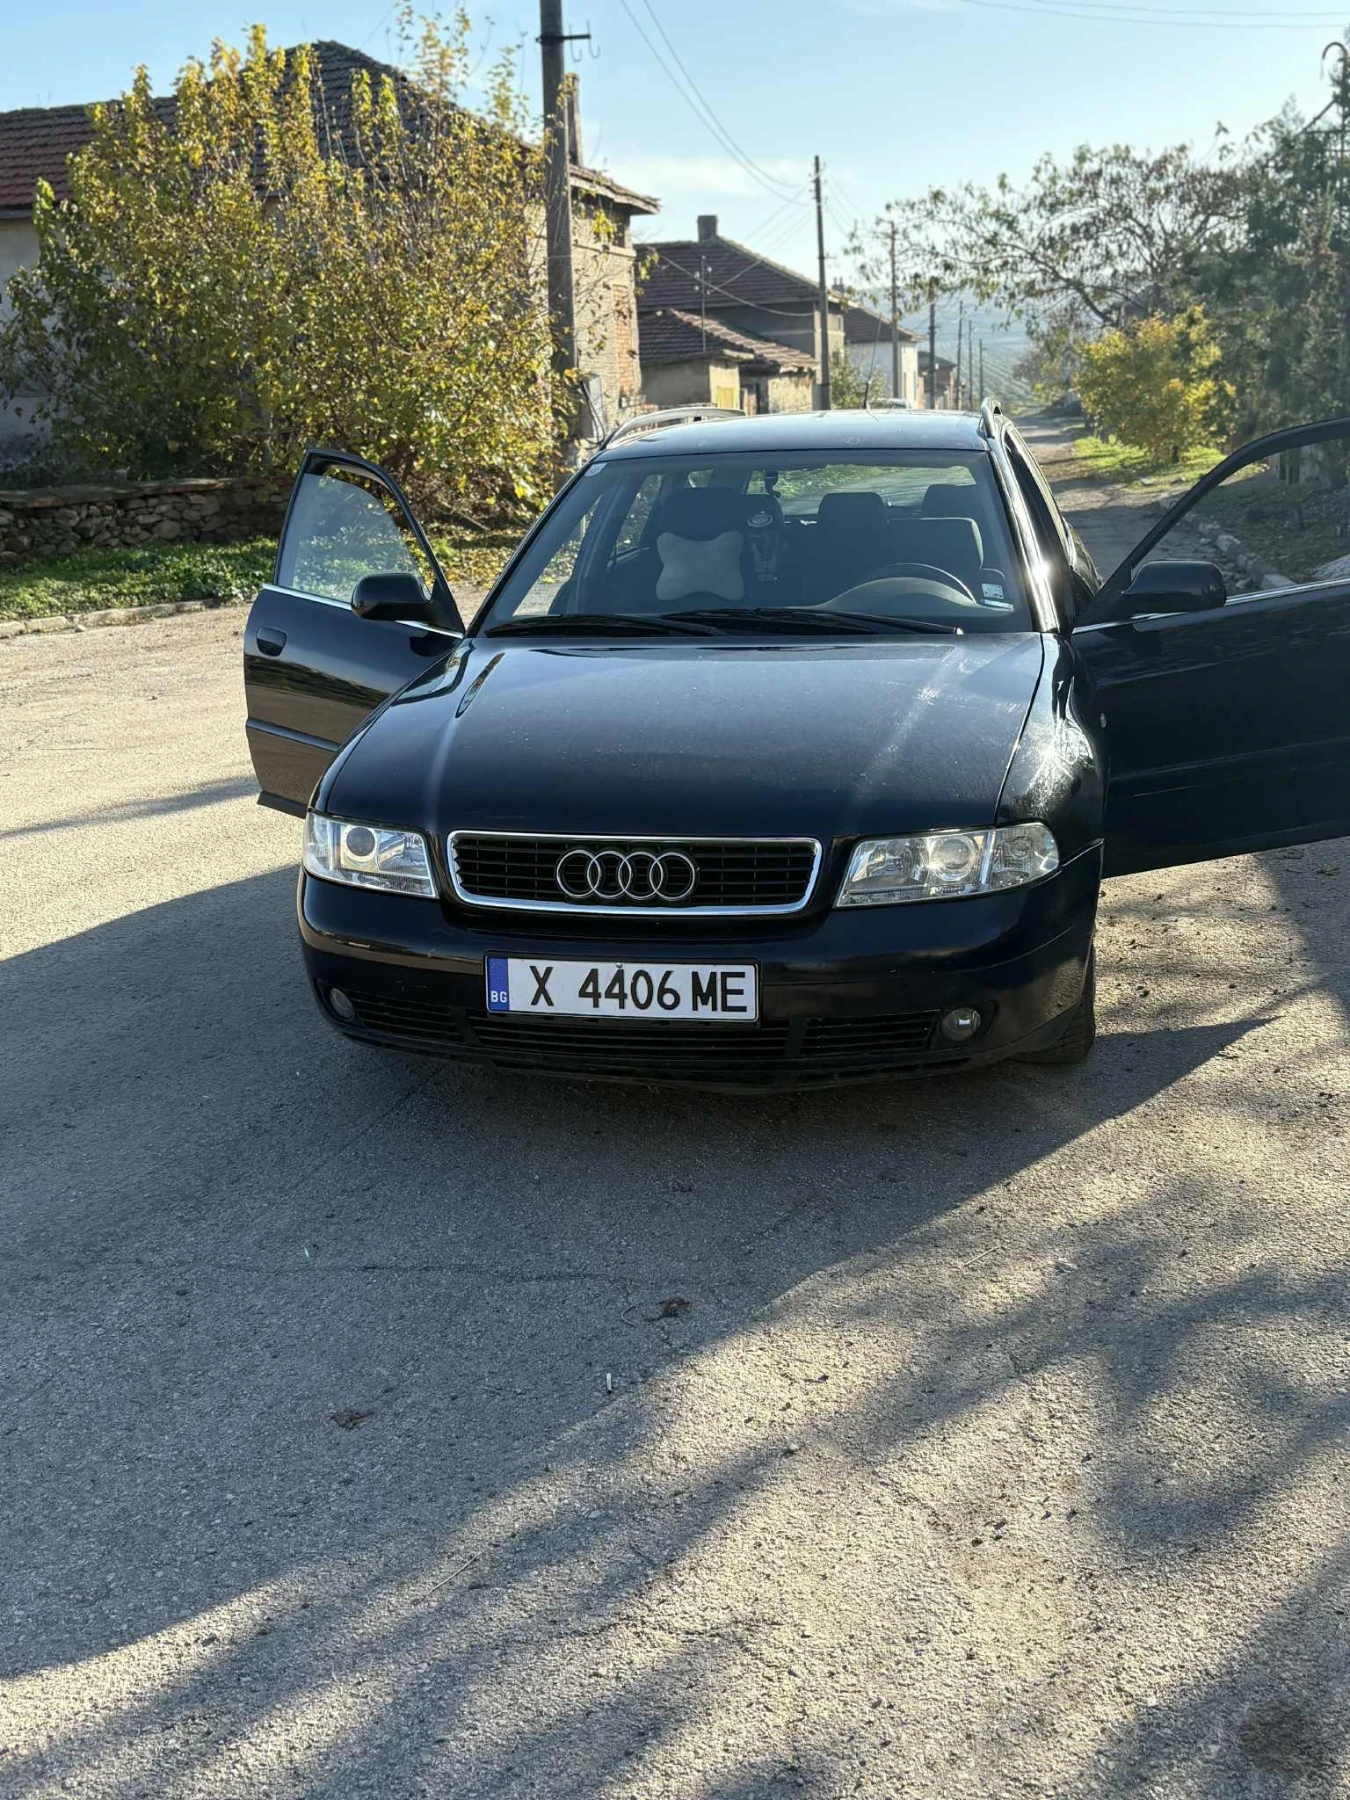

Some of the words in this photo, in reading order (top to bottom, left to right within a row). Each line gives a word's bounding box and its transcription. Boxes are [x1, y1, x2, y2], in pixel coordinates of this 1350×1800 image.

[490, 990, 507, 1004] BG
[529, 965, 555, 1007] X
[578, 968, 681, 1011] 4406
[691, 970, 748, 1013] ME
